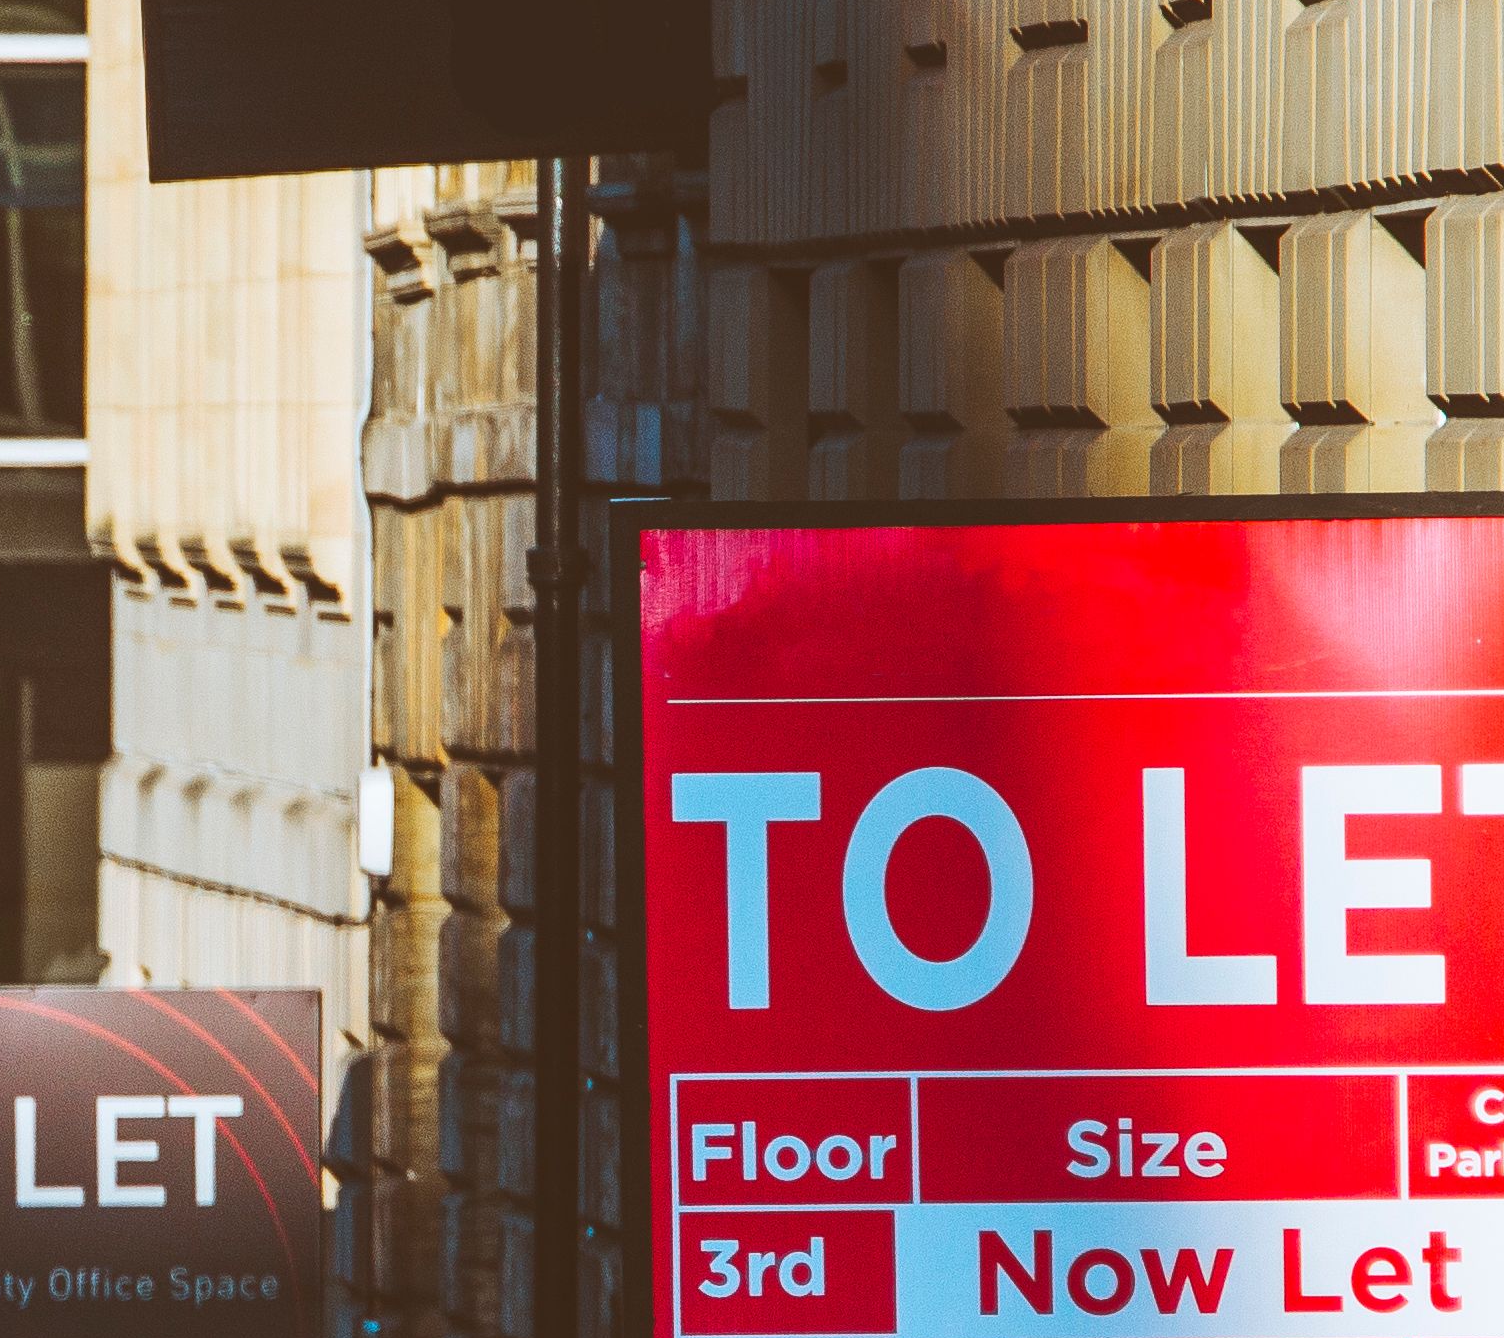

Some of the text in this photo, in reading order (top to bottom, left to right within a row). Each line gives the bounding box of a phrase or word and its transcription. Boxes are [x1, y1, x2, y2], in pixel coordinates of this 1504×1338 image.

[670, 765, 1035, 1013] TO
[13, 1094, 245, 1208] LET
[690, 1117, 1229, 1183] Floor Size
[48, 1266, 155, 1302] Office
[169, 1266, 279, 1308] Space
[698, 1228, 1462, 1316] 3rd Now Let
